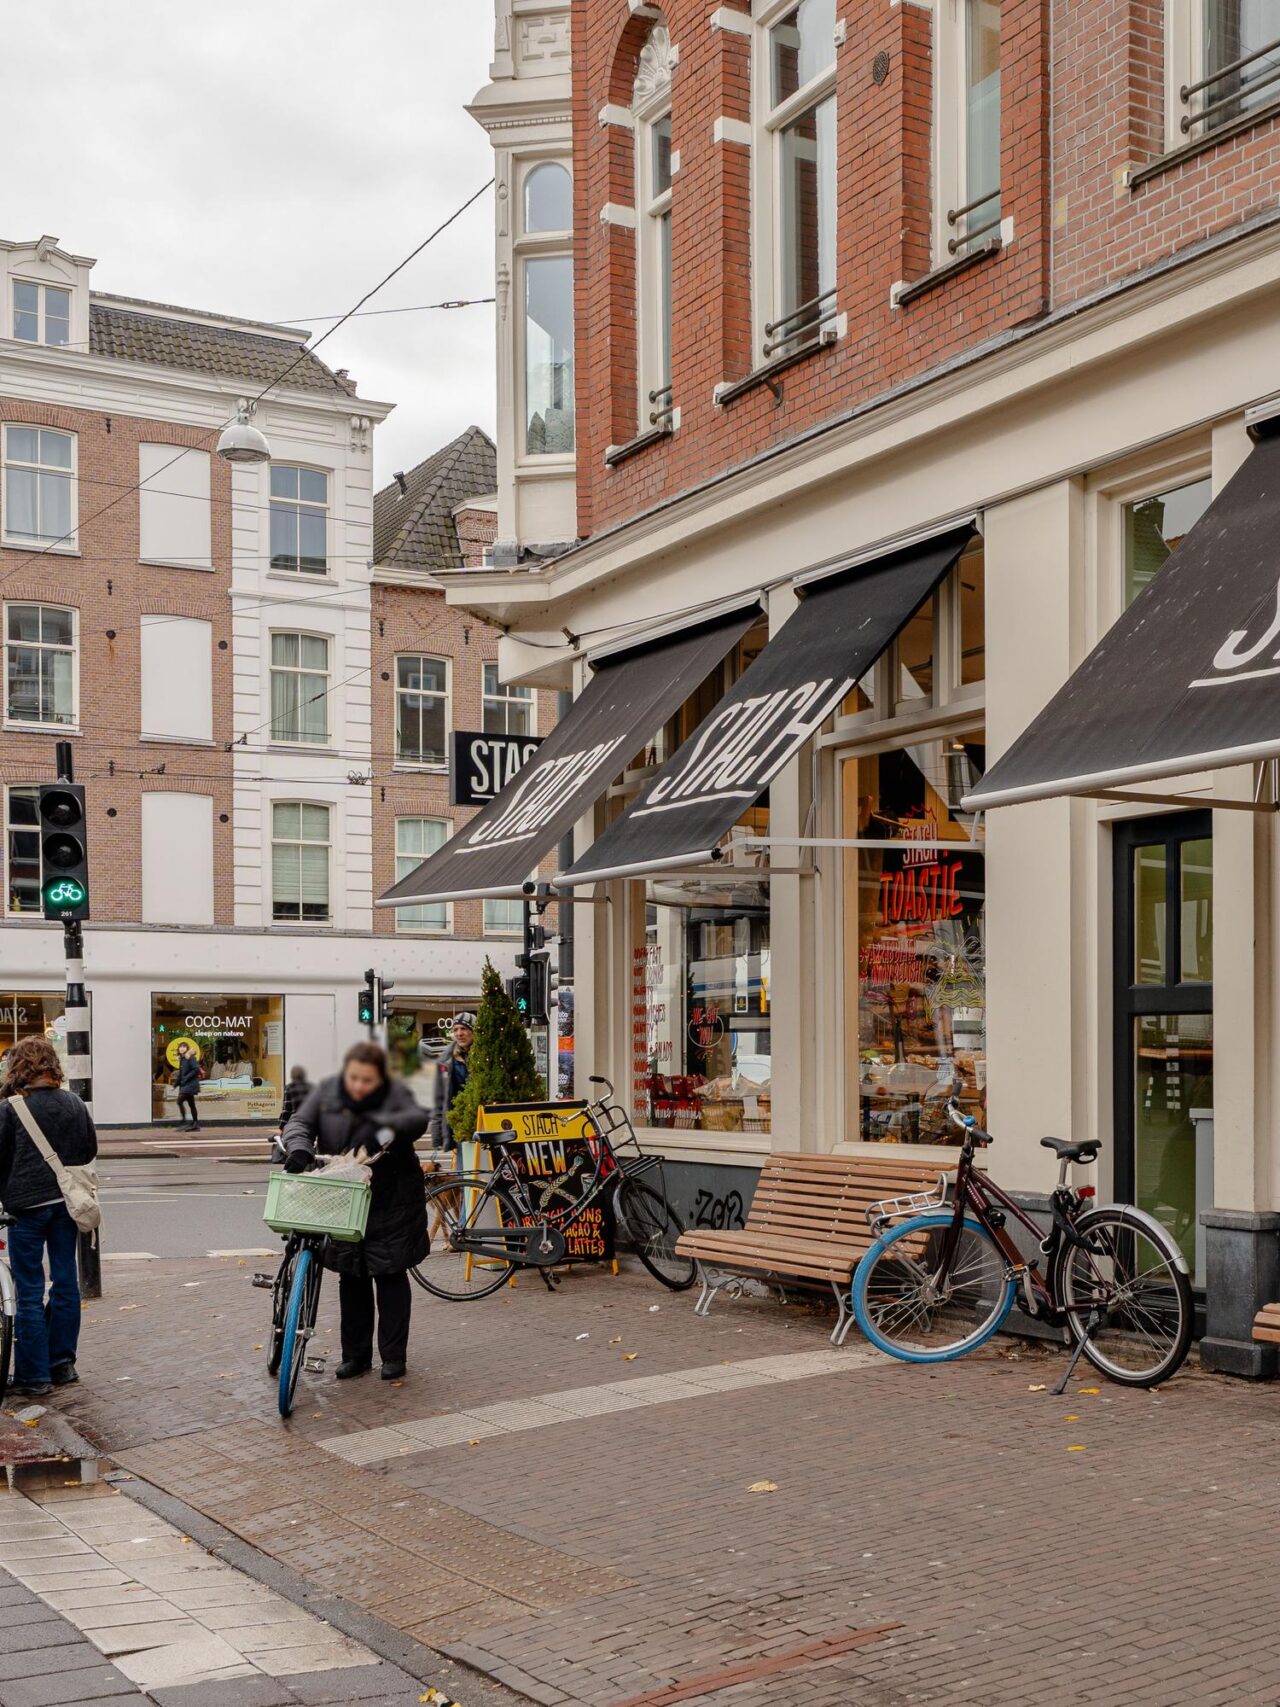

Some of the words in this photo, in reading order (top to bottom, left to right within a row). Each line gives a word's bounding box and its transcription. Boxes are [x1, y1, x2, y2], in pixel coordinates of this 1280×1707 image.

[646, 677, 856, 804] STACH
[470, 739, 537, 793] STA
[469, 734, 627, 844] STACH
[880, 861, 963, 925] TOASTIE
[185, 1015, 254, 1028] COCO-MAT
[195, 1030, 213, 1038] sleep
[522, 1113, 559, 1136] STACH
[524, 1140, 567, 1176] NEW
[568, 1237, 605, 1256] LATTES
